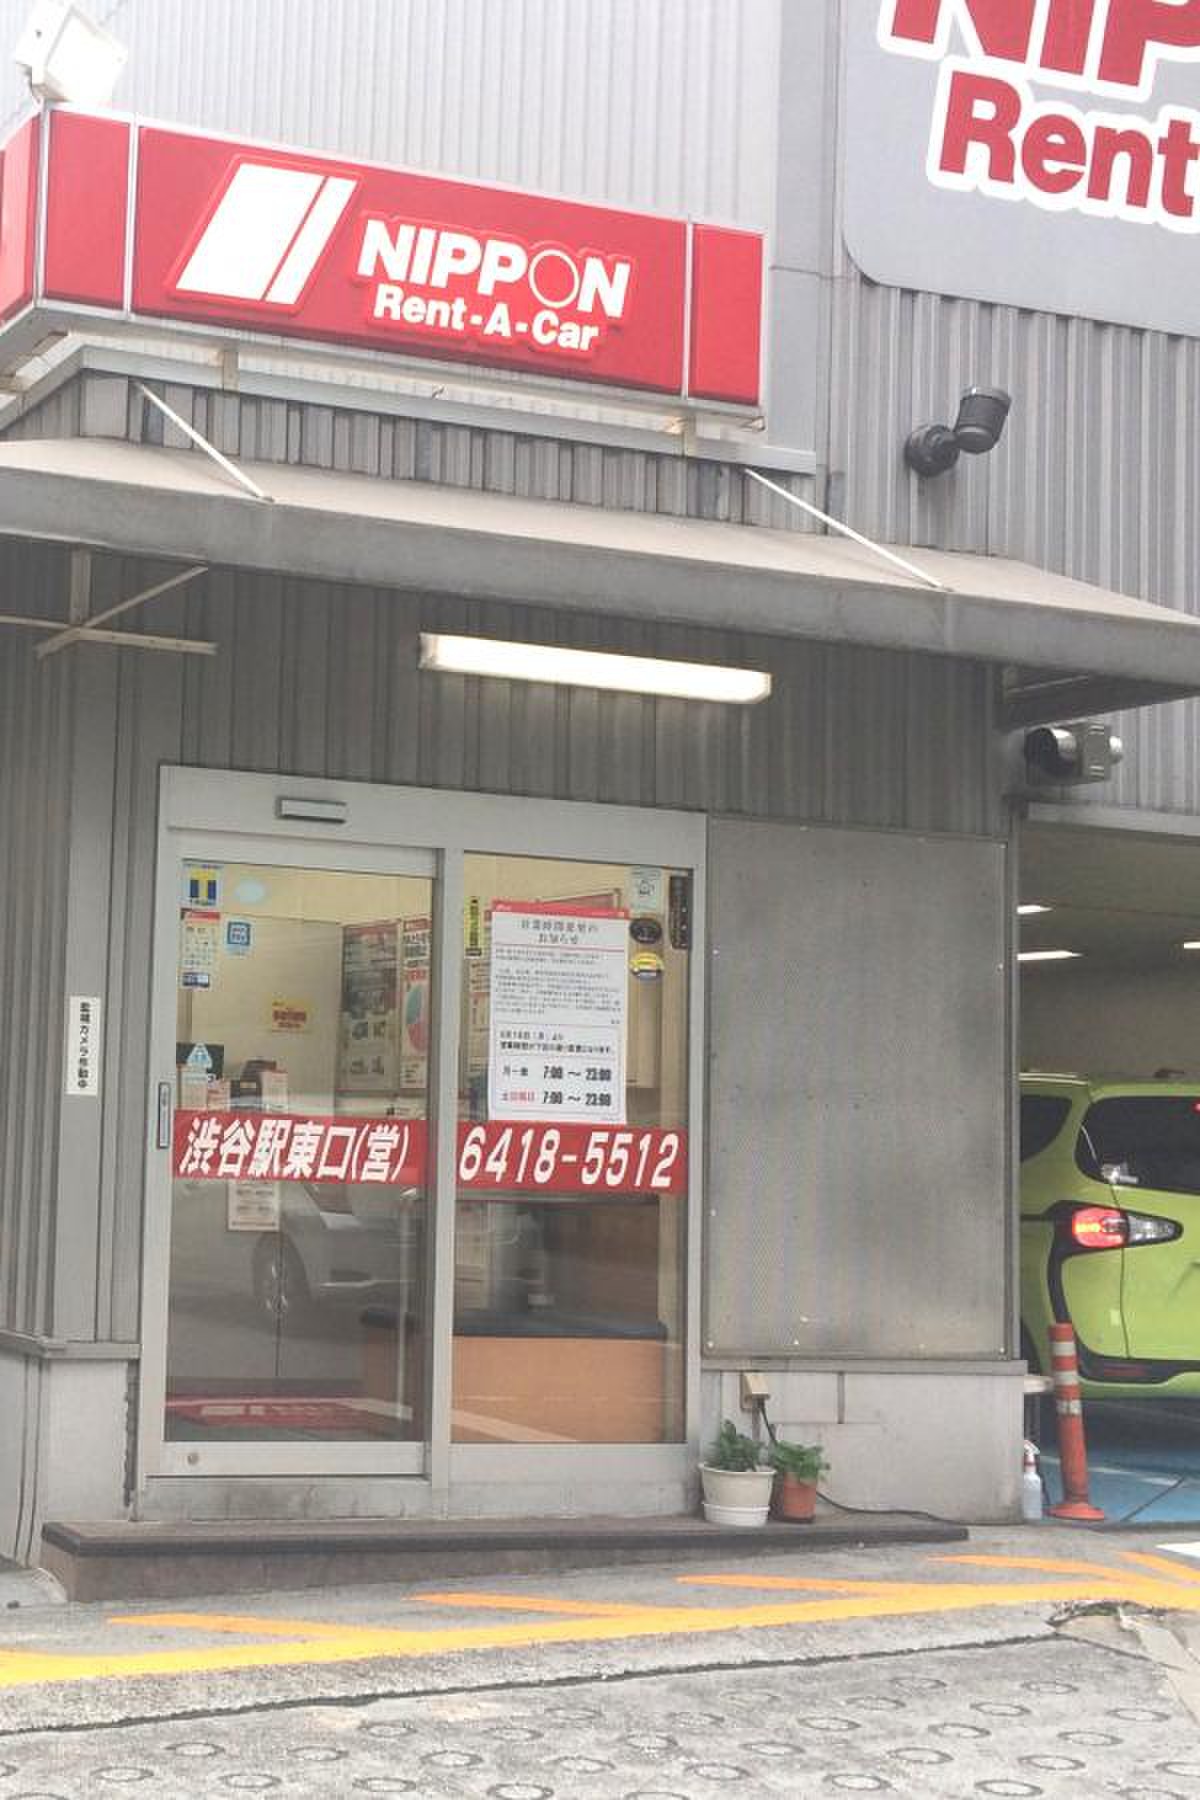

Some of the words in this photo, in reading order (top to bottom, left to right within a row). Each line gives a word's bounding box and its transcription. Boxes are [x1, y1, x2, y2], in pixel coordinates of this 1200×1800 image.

[356, 218, 631, 319] NIPPON
[372, 284, 599, 351] Rent-A-Car
[179, 1117, 409, 1182] 渋谷駅東口(営)
[459, 1126, 679, 1187] 6418-5512
